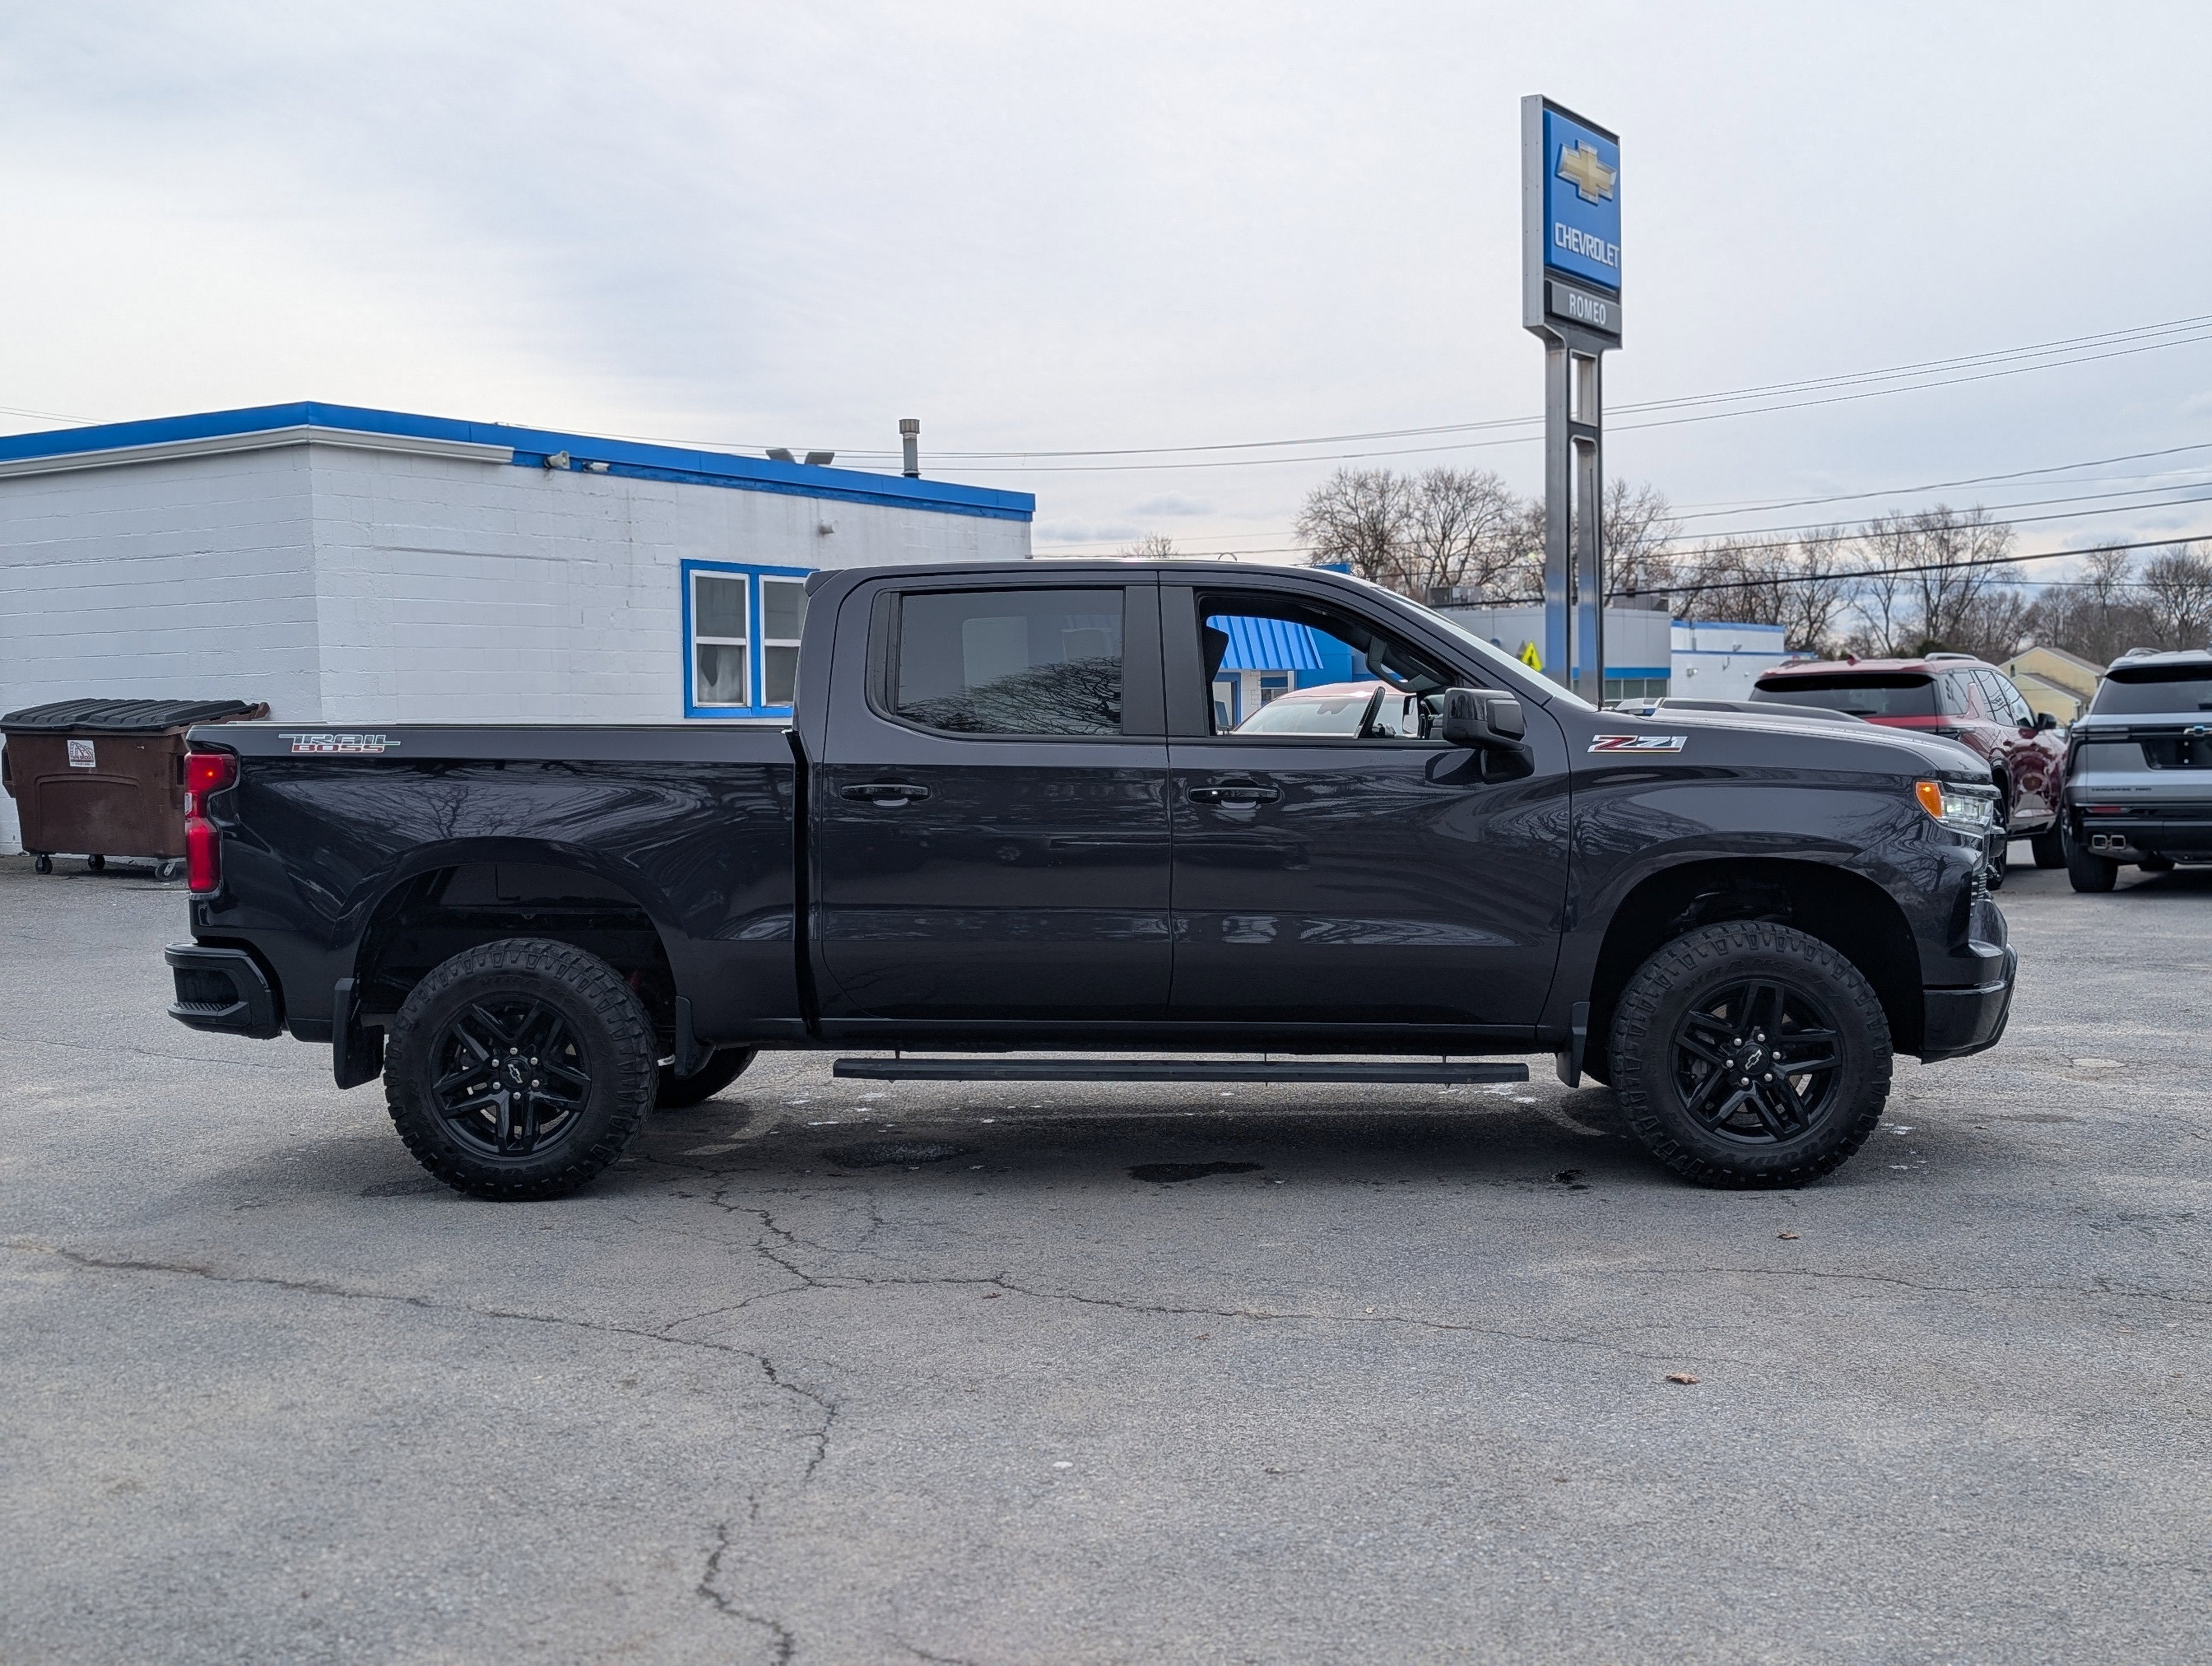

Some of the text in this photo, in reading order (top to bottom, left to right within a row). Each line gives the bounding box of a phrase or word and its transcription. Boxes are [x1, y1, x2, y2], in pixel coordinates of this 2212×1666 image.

[1555, 222, 1619, 268] CHEVROLET
[1569, 293, 1606, 325] ROMEO
[279, 734, 401, 746] TRAIL
[291, 744, 384, 753] BOSS
[1587, 735, 1688, 753] Z71
